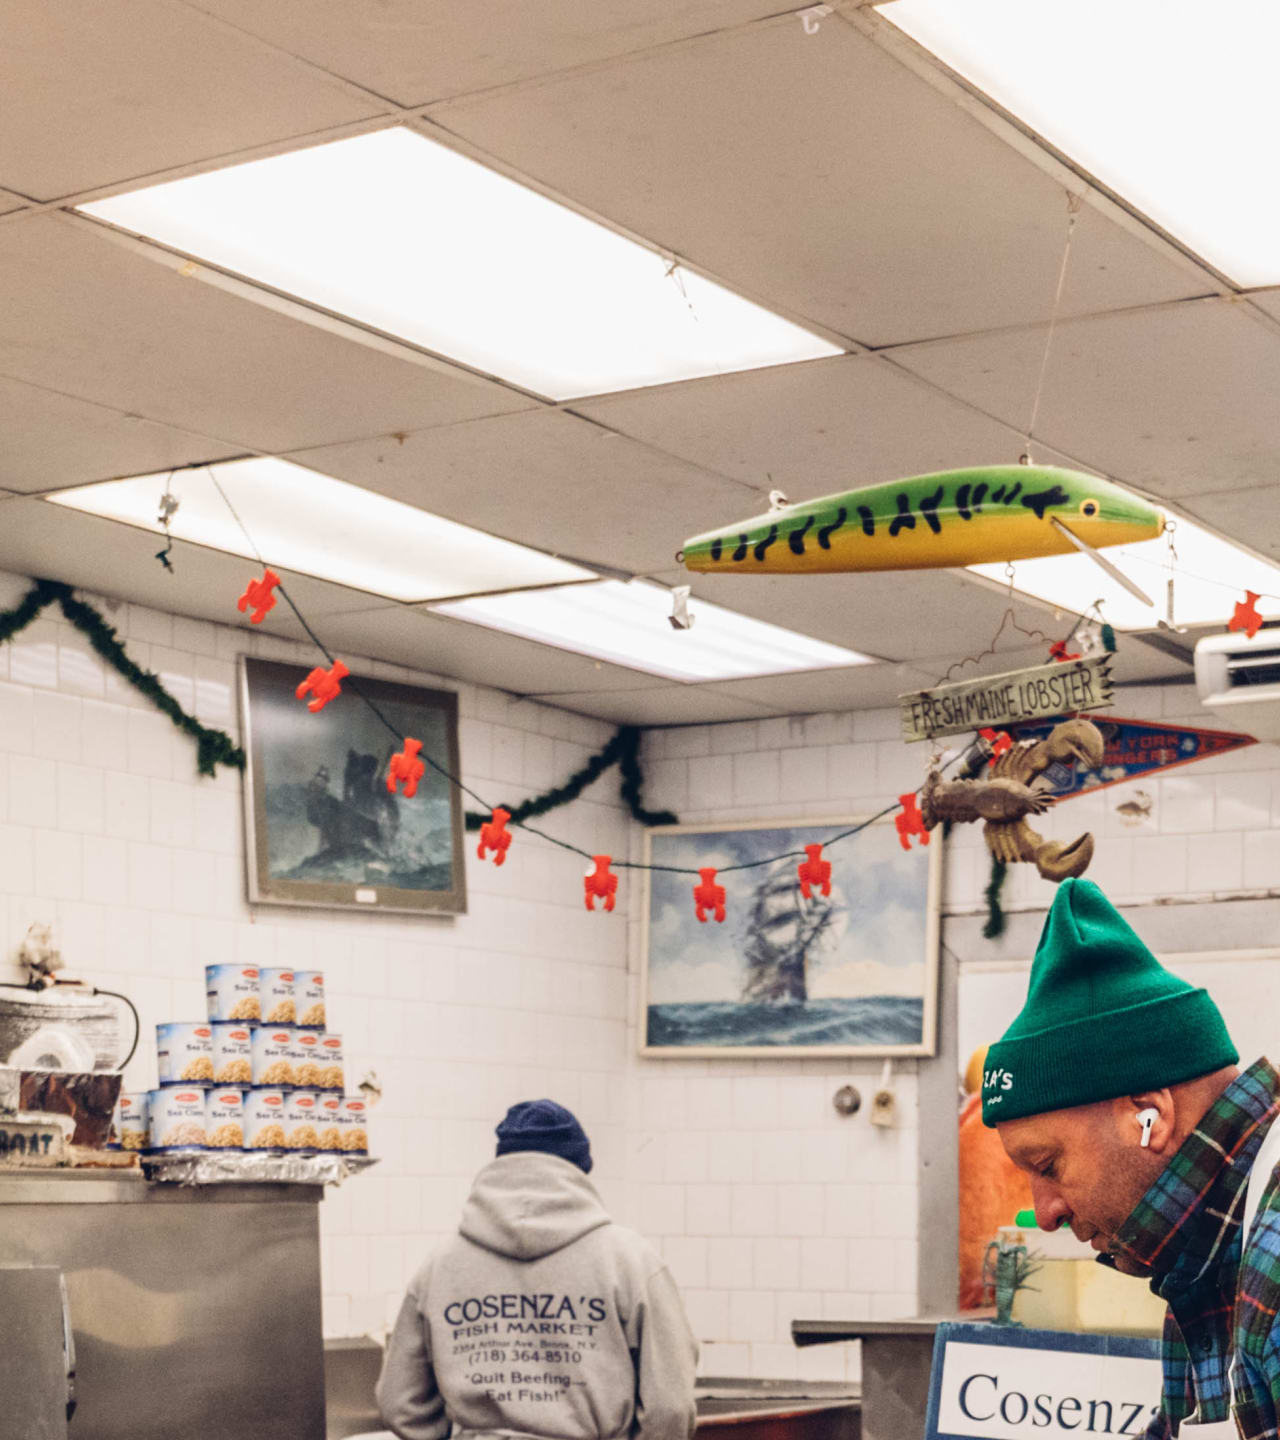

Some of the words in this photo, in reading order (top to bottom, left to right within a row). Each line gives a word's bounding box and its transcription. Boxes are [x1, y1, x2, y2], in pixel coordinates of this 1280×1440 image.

[911, 695, 962, 733] FRESH
[961, 685, 1018, 721] MAINE
[1019, 667, 1095, 714] LOBSTER
[984, 1068, 1013, 1090] ZA'S
[444, 1294, 606, 1326] COSENZA'S
[453, 1323, 498, 1340] FISH
[507, 1323, 598, 1336] MARKET
[479, 1340, 510, 1349] Arthur
[469, 1351, 506, 1365] (718)
[512, 1351, 581, 1363] 364-8510
[486, 1390, 512, 1401] Eat
